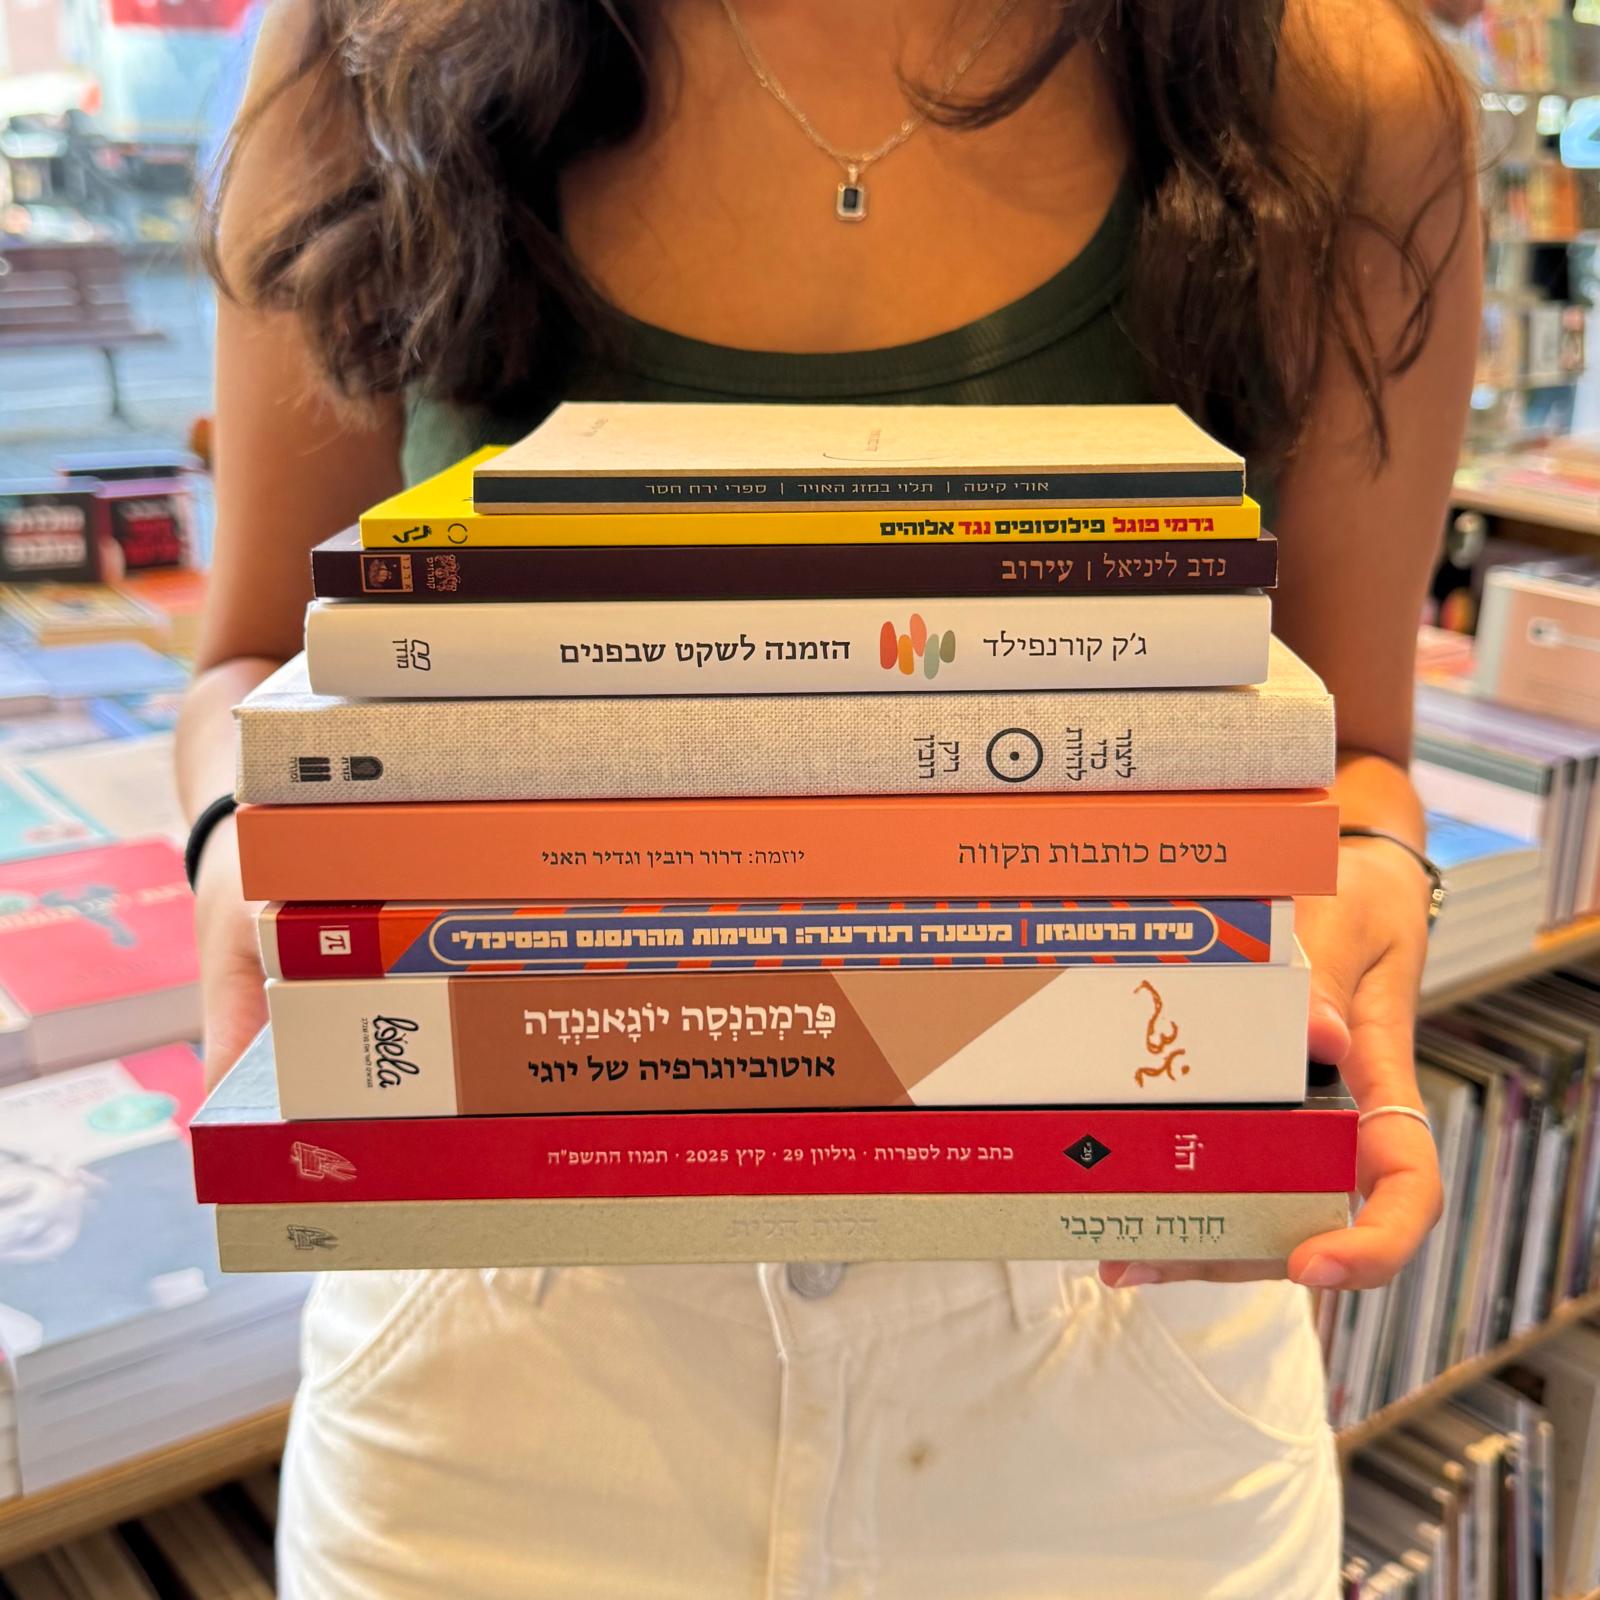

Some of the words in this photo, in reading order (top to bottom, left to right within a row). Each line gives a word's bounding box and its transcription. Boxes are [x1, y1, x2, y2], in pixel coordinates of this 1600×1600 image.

[645, 484, 682, 495] חסר
[689, 485, 718, 494] ירח
[725, 484, 767, 494] ספרי
[797, 483, 845, 494] האויר
[851, 483, 890, 493] במזג
[897, 481, 933, 493] תלוי
[964, 481, 1007, 494] קיטה
[1013, 481, 1049, 492] אורי
[879, 519, 955, 536] אלוהים
[958, 520, 991, 536] נגד
[994, 517, 1106, 534] פילוסופים
[1112, 516, 1160, 533] פוגל
[1001, 559, 1074, 582] עירוב
[1103, 551, 1178, 579] ליניאל
[1187, 556, 1227, 578] נדב
[559, 643, 667, 664] שבפנים
[674, 633, 756, 668] לשקט
[764, 639, 851, 661] הזמנה
[983, 630, 1103, 662] קורנפילד
[913, 733, 936, 780] רובין
[938, 740, 960, 773] ריק
[1066, 727, 1088, 782] להיות
[1090, 738, 1109, 770] כדי
[1115, 728, 1137, 779] ליצור
[541, 850, 588, 866] האני
[592, 850, 642, 866] וגדיר
[646, 850, 695, 869] רובין
[700, 849, 743, 865] דרור
[749, 849, 806, 865] יוזמה:
[958, 841, 1041, 870] תקווה
[1048, 841, 1150, 865] כותבות
[1159, 842, 1228, 865] נשים
[451, 929, 569, 950] הפסיכדלי
[576, 928, 684, 948] מהרנסנס
[692, 926, 788, 946] רשימות
[795, 924, 914, 945] תודעה:
[920, 923, 1013, 943] משנה
[1035, 922, 1137, 945] הרטוגזון
[1143, 921, 1195, 941] עידו
[527, 1059, 579, 1084] יוגי
[587, 1054, 630, 1082] של
[638, 1055, 836, 1081] אוטוביוגרפיה
[627, 1149, 669, 1164] תמוז
[685, 1149, 729, 1163] 2025
[735, 1148, 767, 1167] קיץ
[783, 1148, 804, 1162] 29
[810, 1143, 857, 1166] גיליון
[873, 1143, 942, 1162] לספרות
[946, 1147, 972, 1162] עת
[977, 1146, 1015, 1161] כתב
